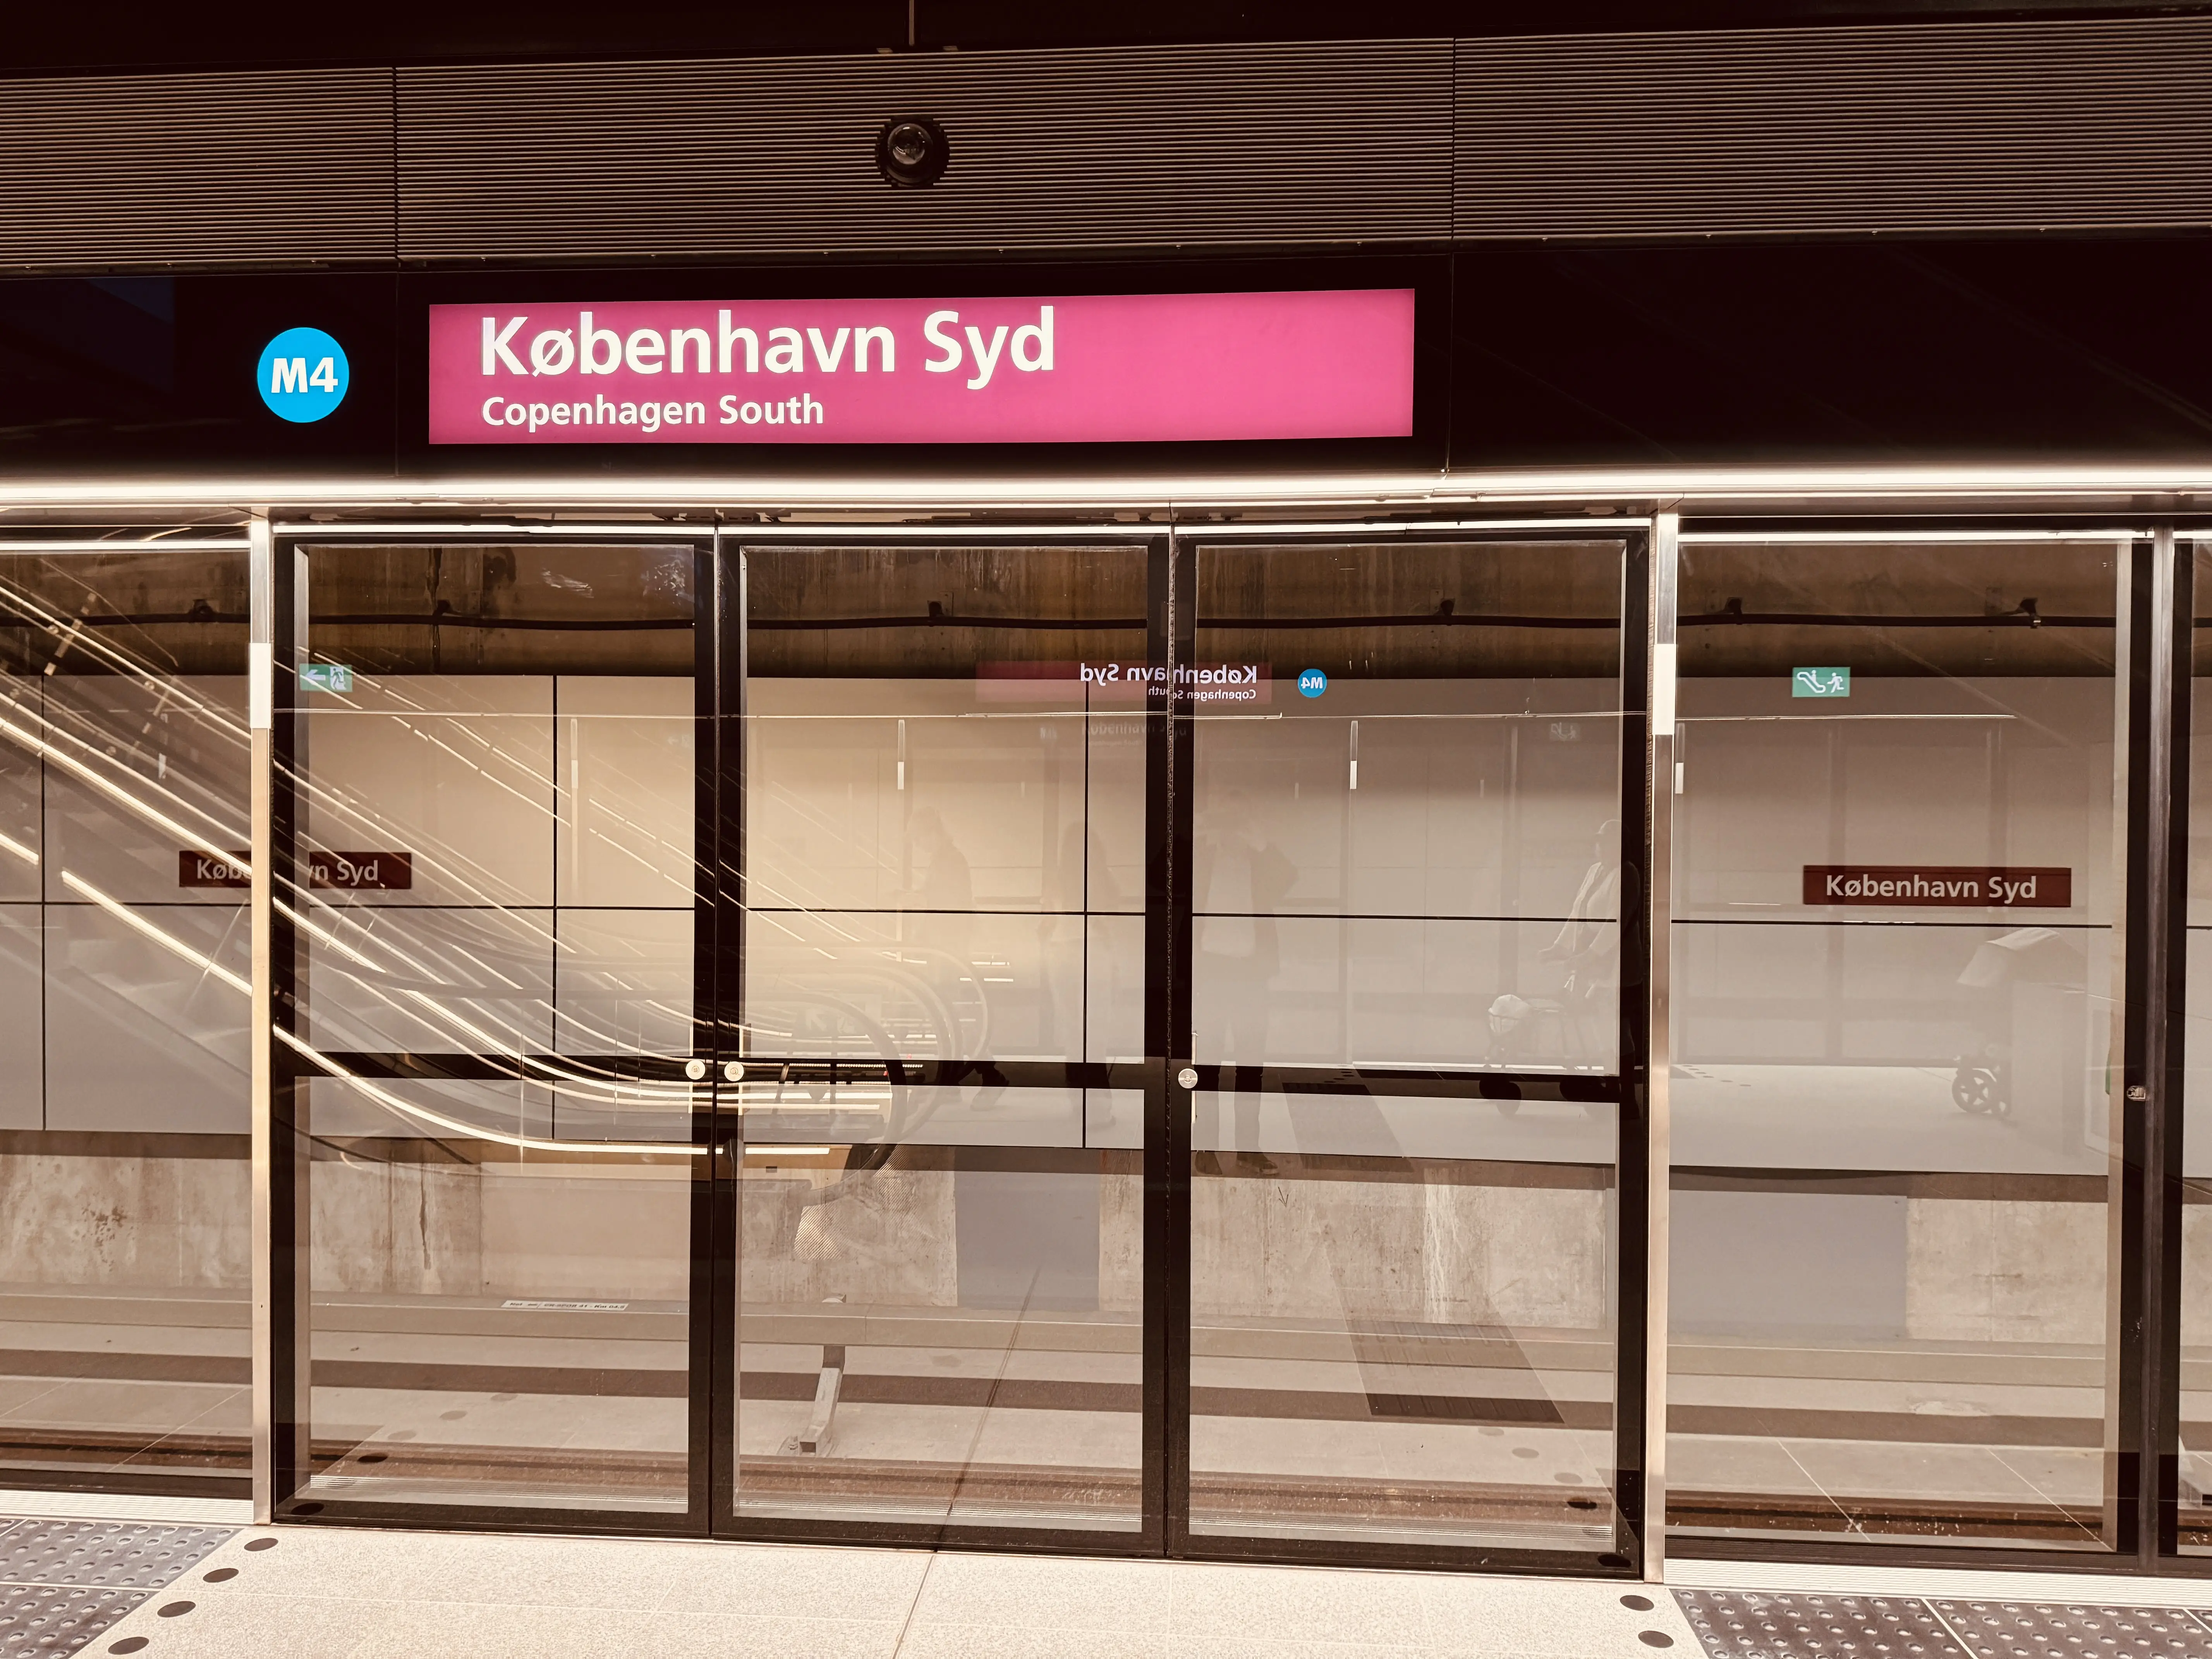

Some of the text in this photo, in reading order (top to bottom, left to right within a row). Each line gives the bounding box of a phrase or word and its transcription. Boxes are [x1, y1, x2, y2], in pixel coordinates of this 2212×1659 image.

[483, 305, 1054, 390] København Syd
[271, 357, 338, 393] M4
[483, 393, 823, 433] Copenhagen South
[337, 859, 378, 886] Syd
[1826, 874, 2037, 904] København Syd
